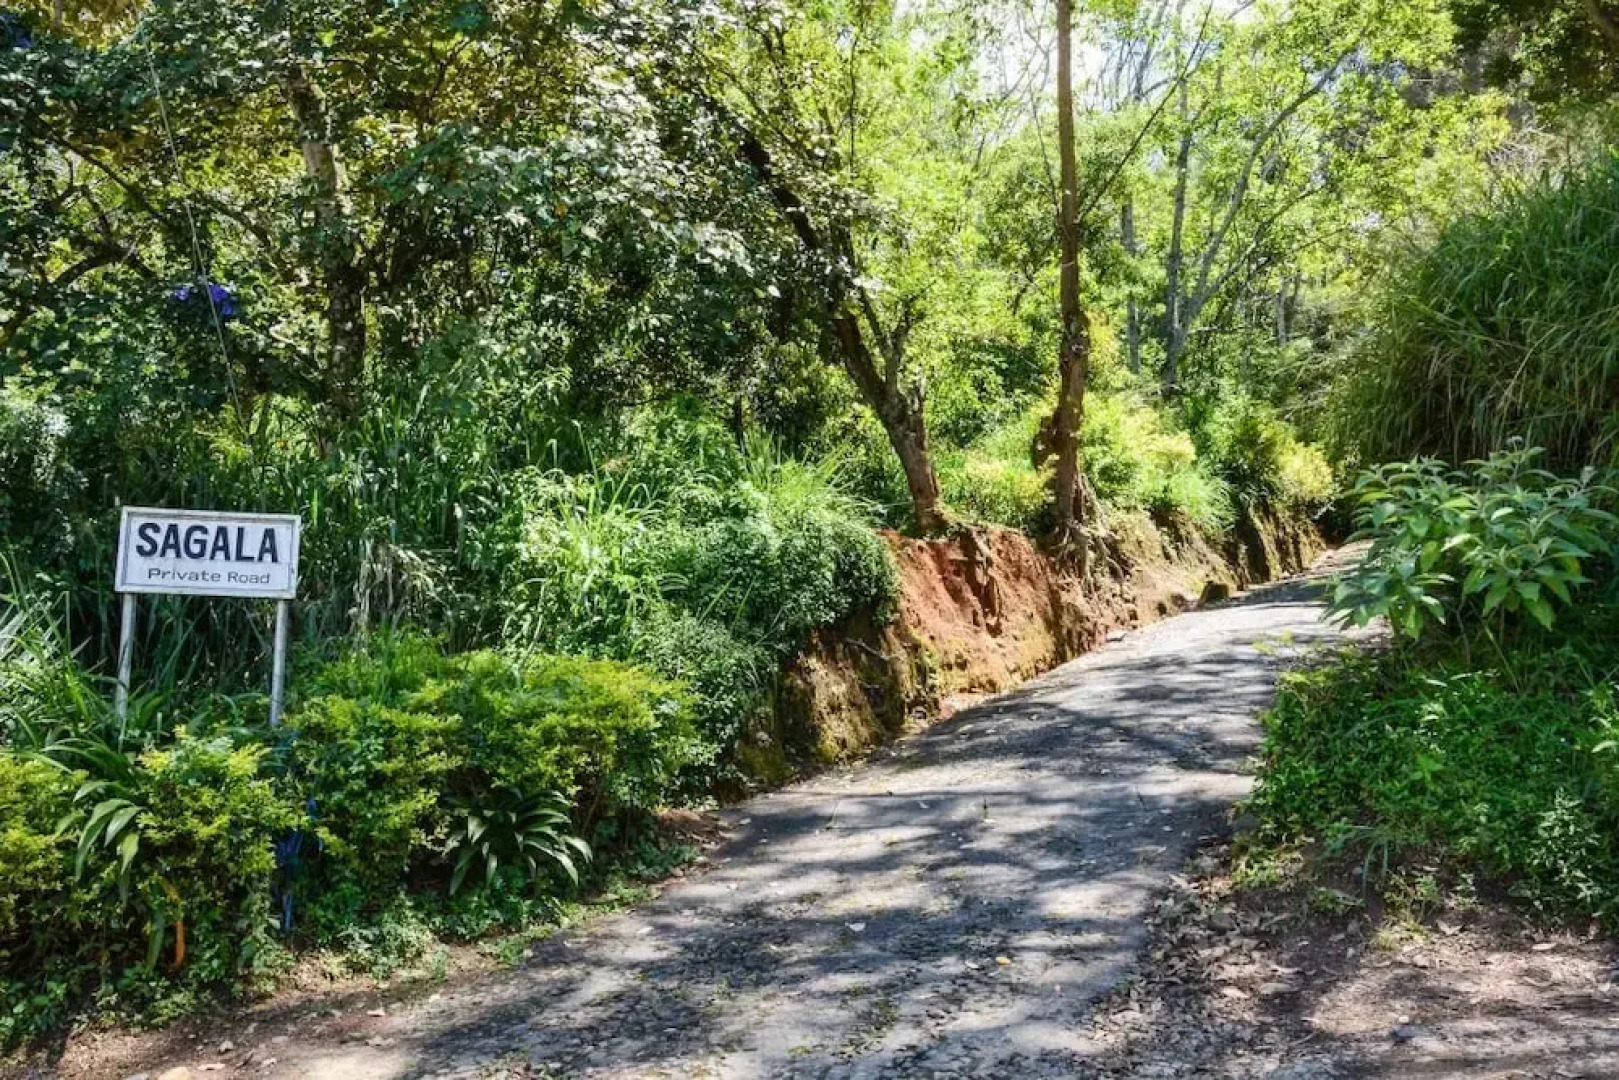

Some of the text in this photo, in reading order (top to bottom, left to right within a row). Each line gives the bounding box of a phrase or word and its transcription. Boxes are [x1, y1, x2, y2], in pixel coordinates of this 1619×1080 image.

[136, 522, 278, 563] SAGALA
[148, 567, 271, 584] Private Road
